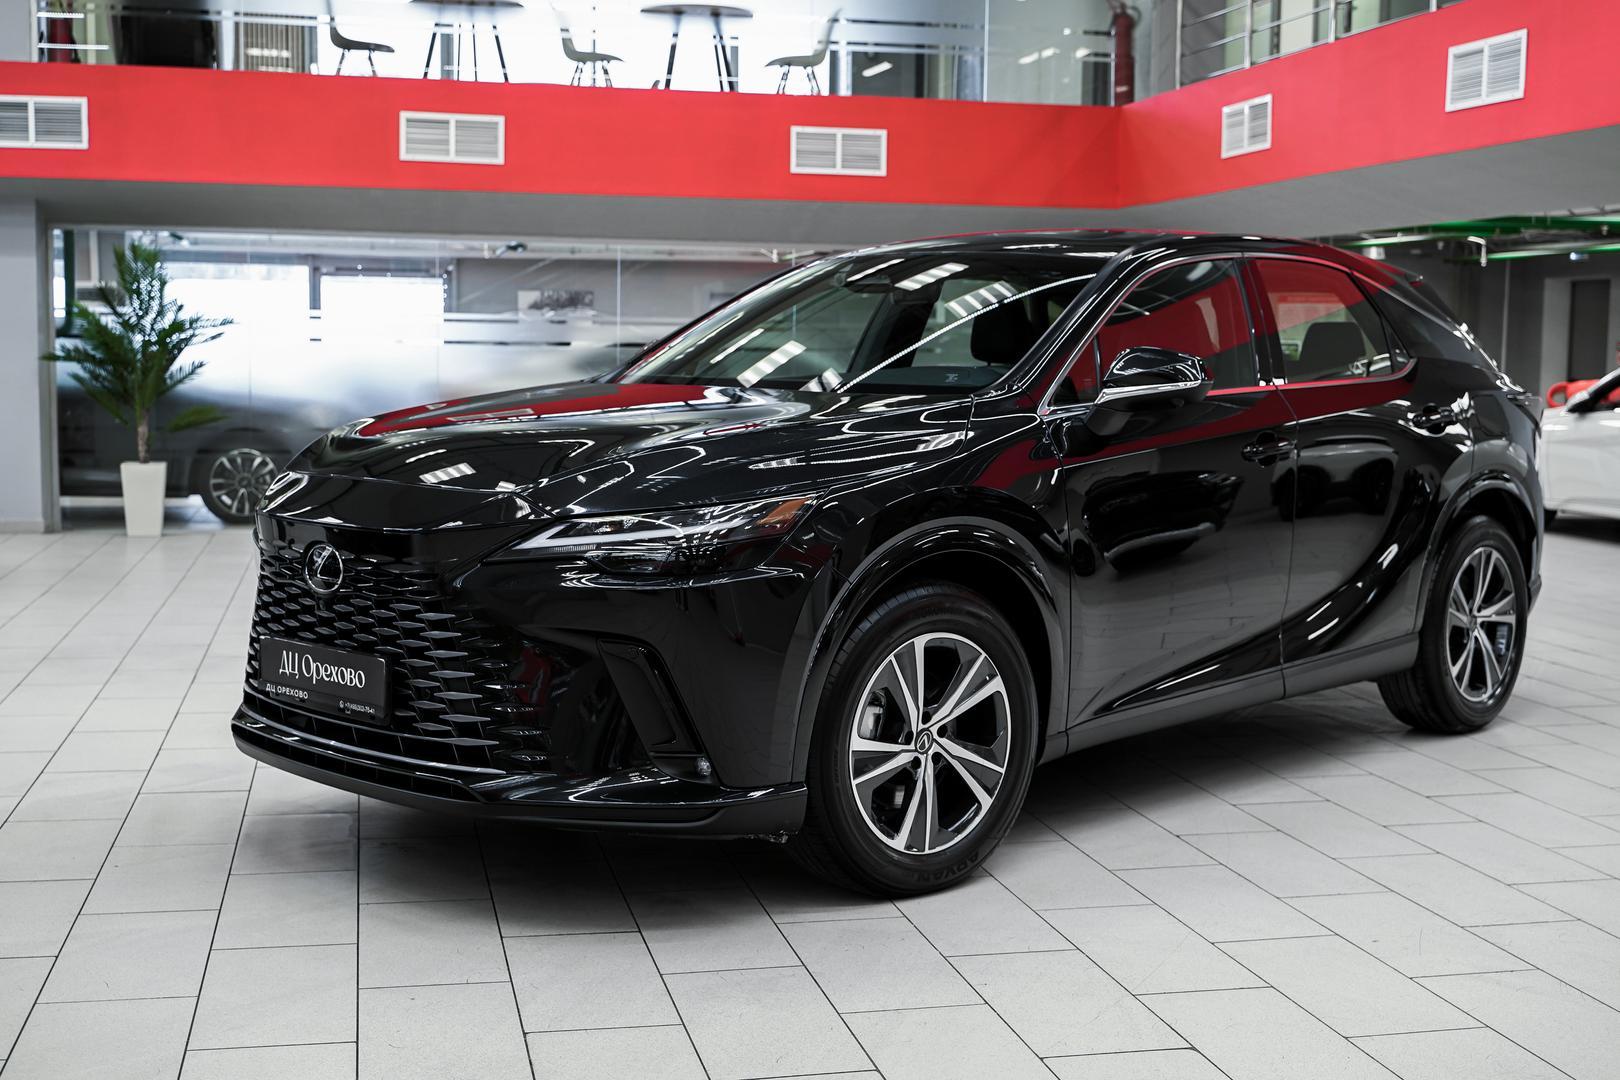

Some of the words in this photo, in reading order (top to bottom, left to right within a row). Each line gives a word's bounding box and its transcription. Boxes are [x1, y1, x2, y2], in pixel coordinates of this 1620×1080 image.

[279, 649, 299, 679] ДЦ
[302, 654, 365, 688] Орехово
[265, 683, 276, 693] ДЦ
[277, 685, 309, 699] ОРЕХОВО
